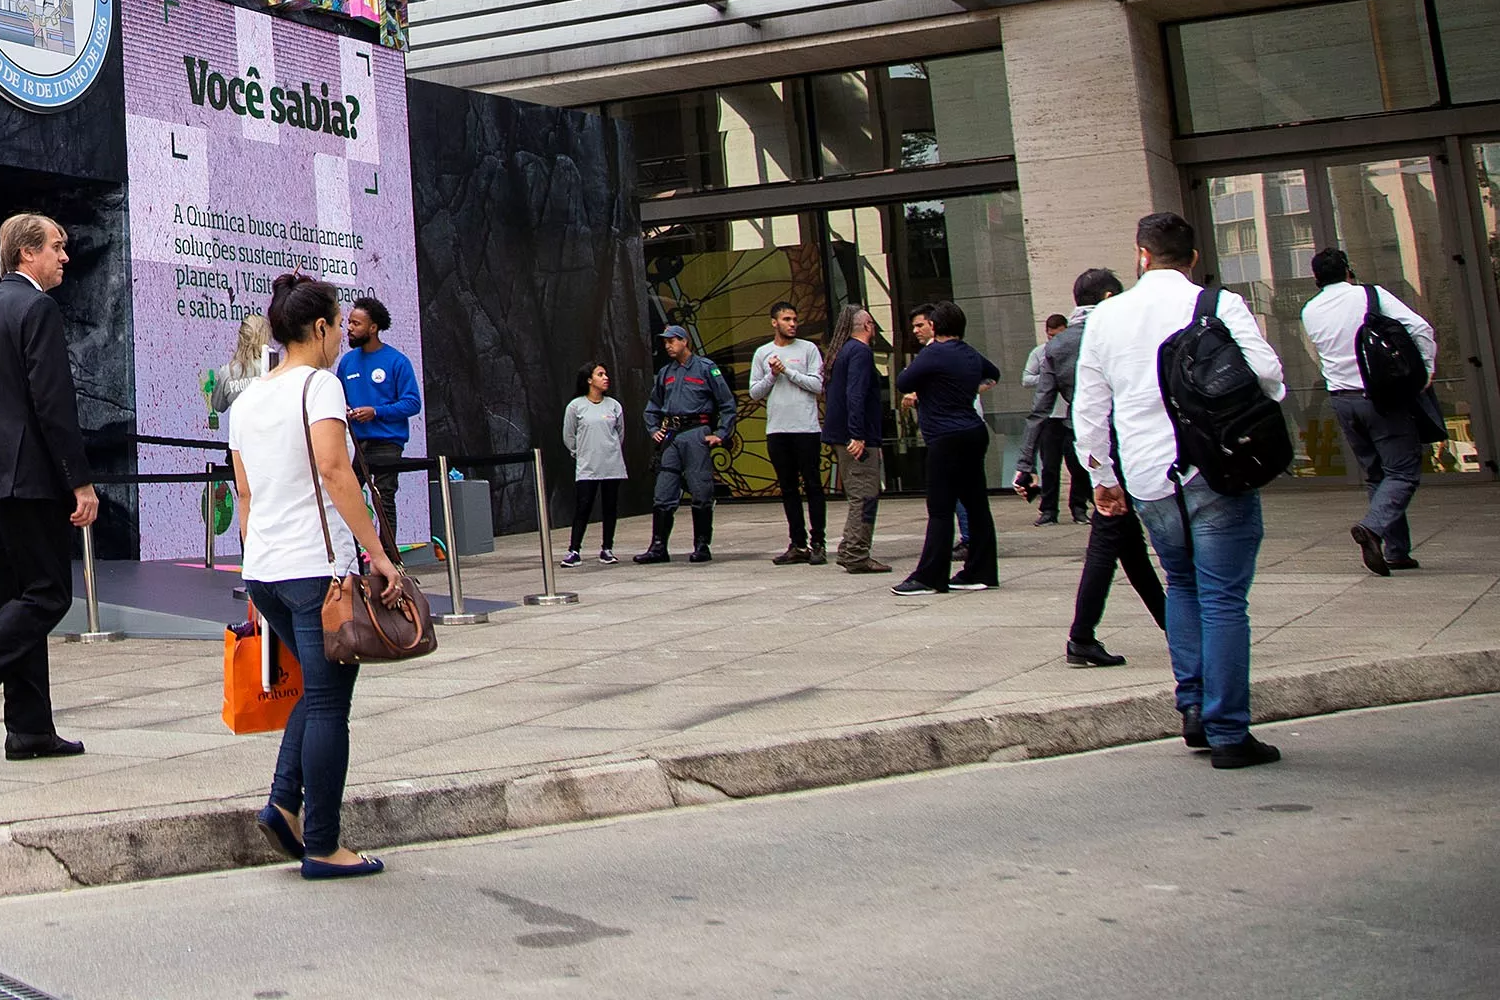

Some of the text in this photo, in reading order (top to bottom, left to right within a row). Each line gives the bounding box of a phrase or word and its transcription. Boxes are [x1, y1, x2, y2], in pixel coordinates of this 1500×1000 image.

[3, 65, 21, 88] DE
[23, 79, 34, 95] 18
[36, 82, 53, 98] DE
[53, 65, 89, 97] JUNHO
[85, 46, 100, 71] DE
[95, 16, 108, 49] 1956
[183, 55, 361, 140] Você sabia?
[174, 204, 364, 250] A Química busca diariamente
[175, 235, 358, 277] soluções sustentáveis para o
[242, 272, 273, 295] Visit
[177, 299, 185, 316] e
[189, 297, 228, 320] saiba
[258, 686, 299, 702] natura
